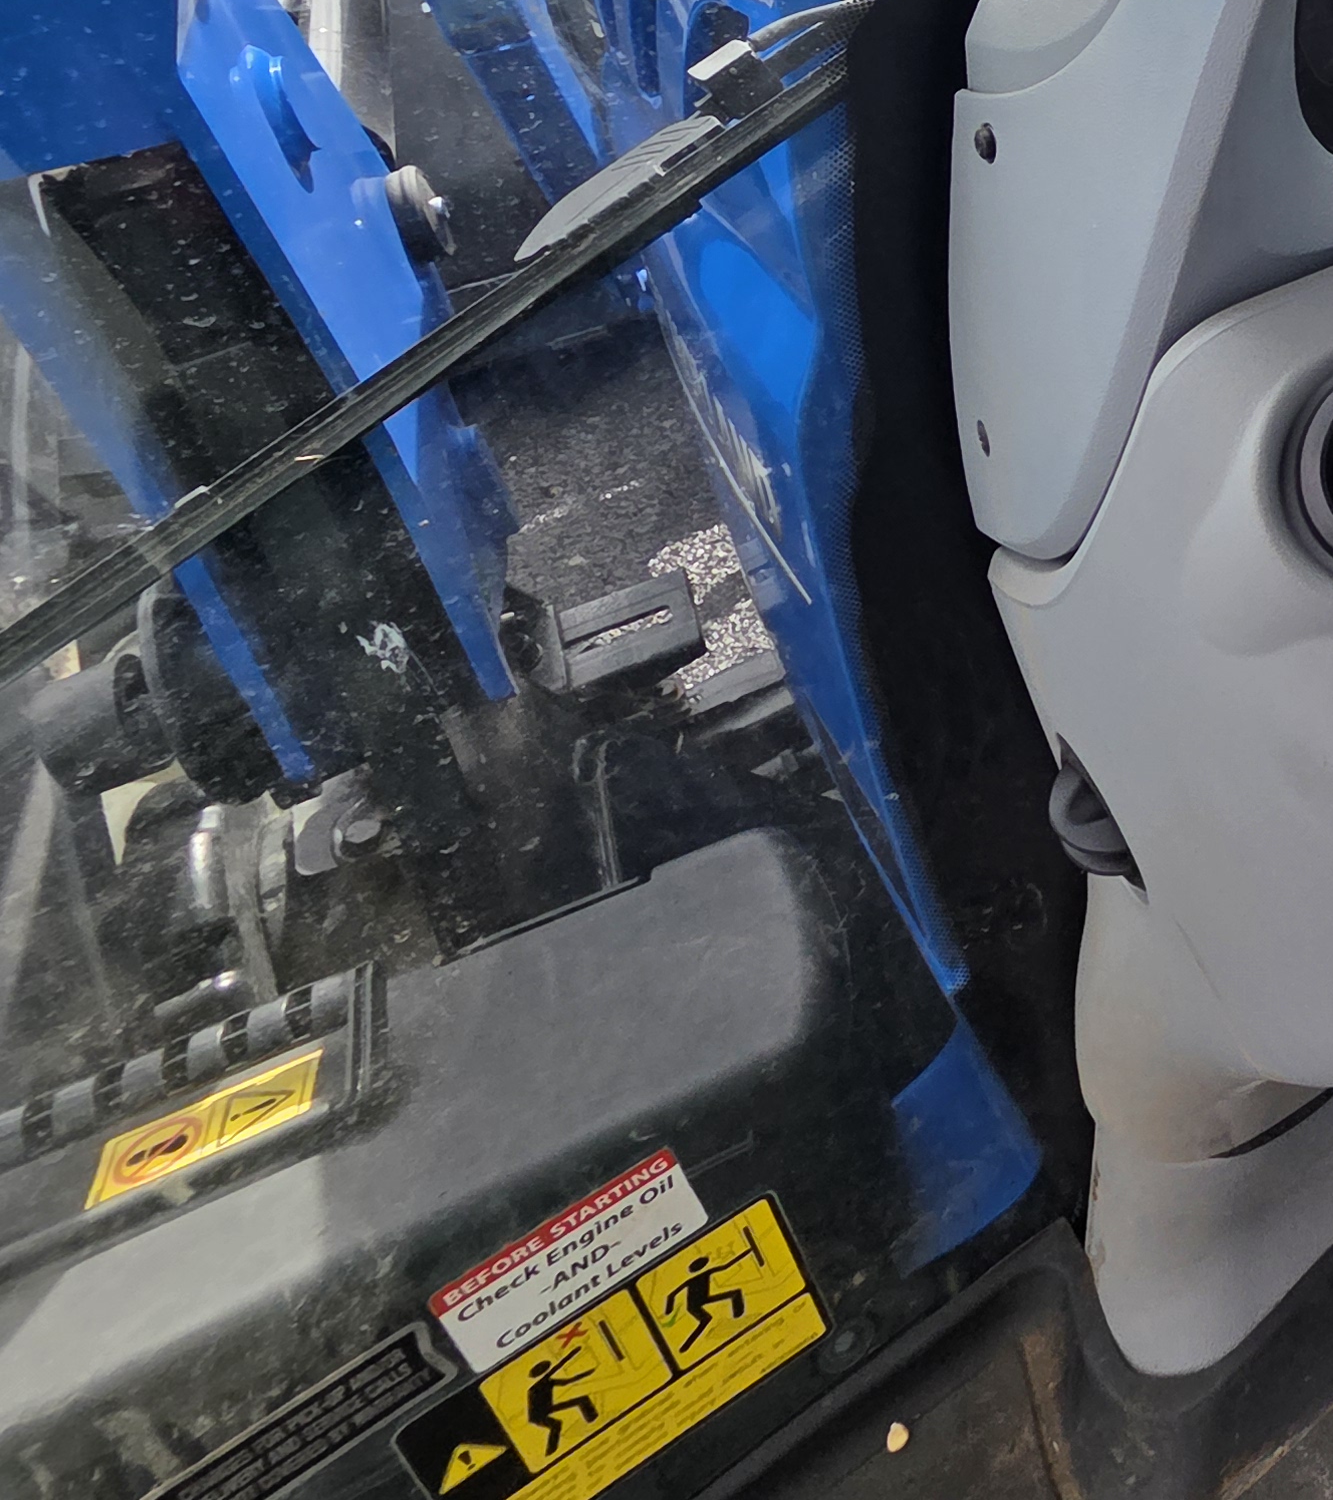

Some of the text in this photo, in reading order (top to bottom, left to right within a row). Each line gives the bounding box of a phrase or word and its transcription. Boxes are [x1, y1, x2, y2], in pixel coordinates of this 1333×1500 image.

[443, 1157, 668, 1307] BEFORE STARTING
[457, 1175, 674, 1322] Check Engine Oil
[496, 1222, 683, 1349] Coolant Levels
